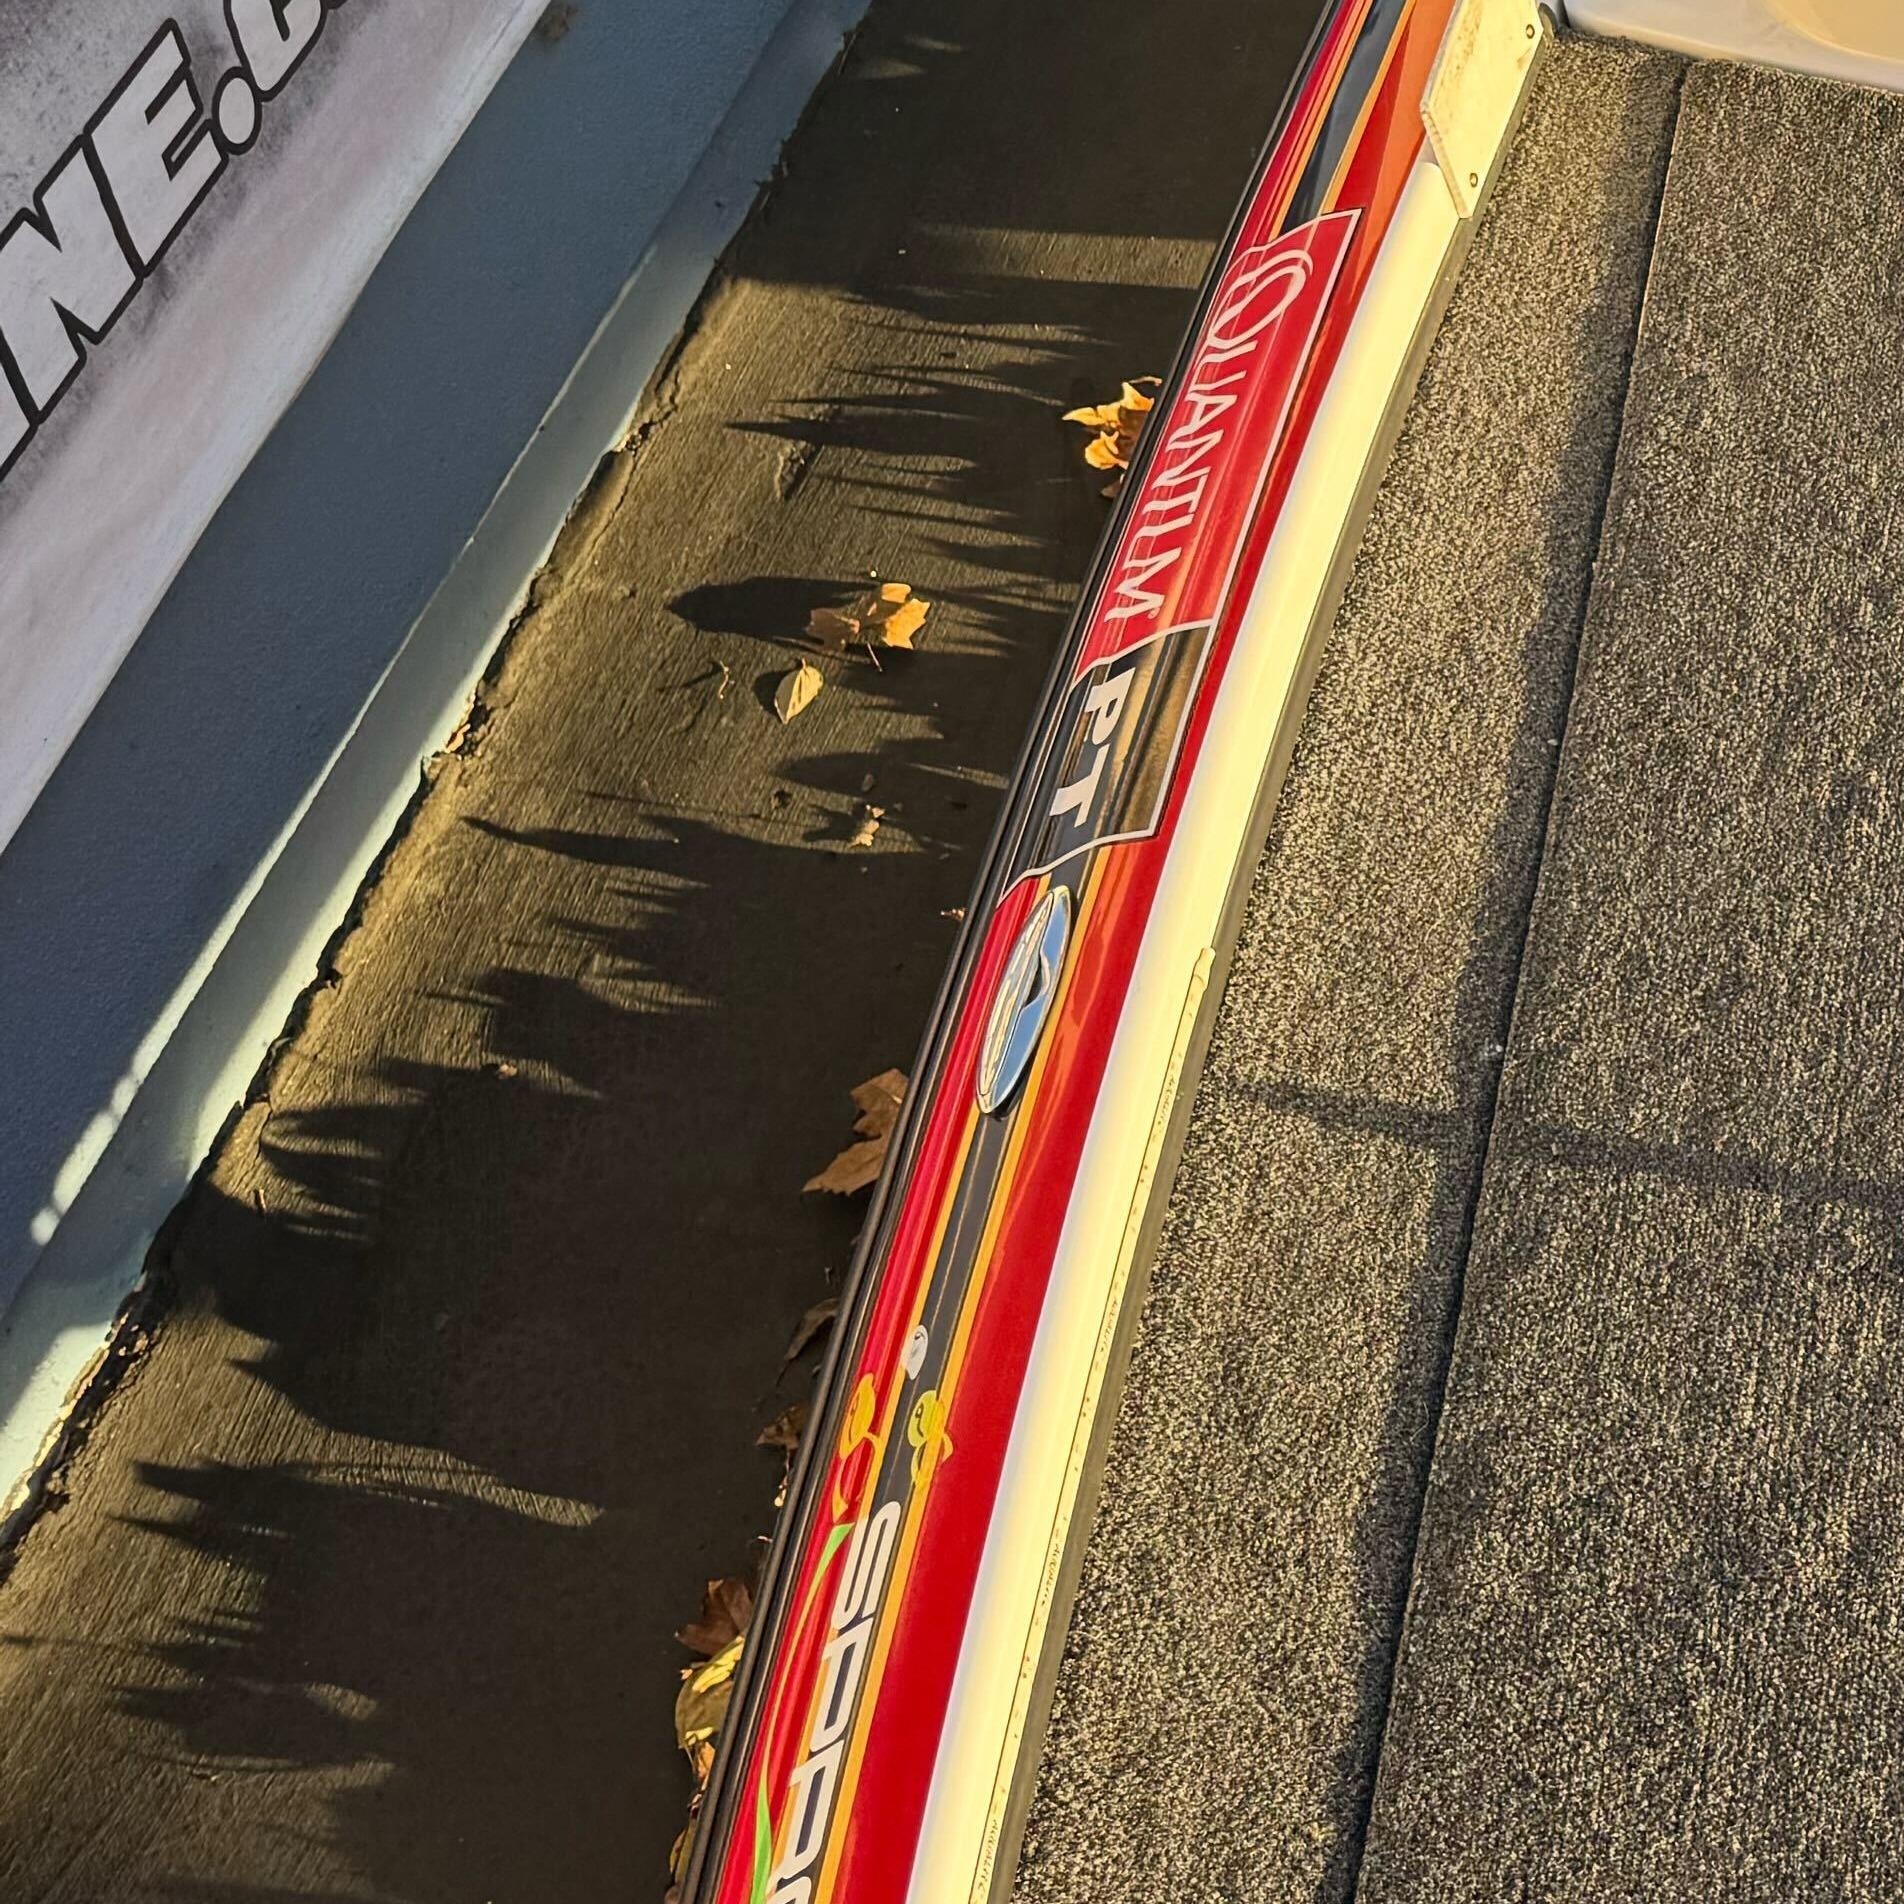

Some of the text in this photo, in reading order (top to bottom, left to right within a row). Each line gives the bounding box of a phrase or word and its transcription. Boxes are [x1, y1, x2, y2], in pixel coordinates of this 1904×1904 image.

[1049, 248, 1315, 829] QUANTUM PT
[766, 1499, 902, 1904] SPR
